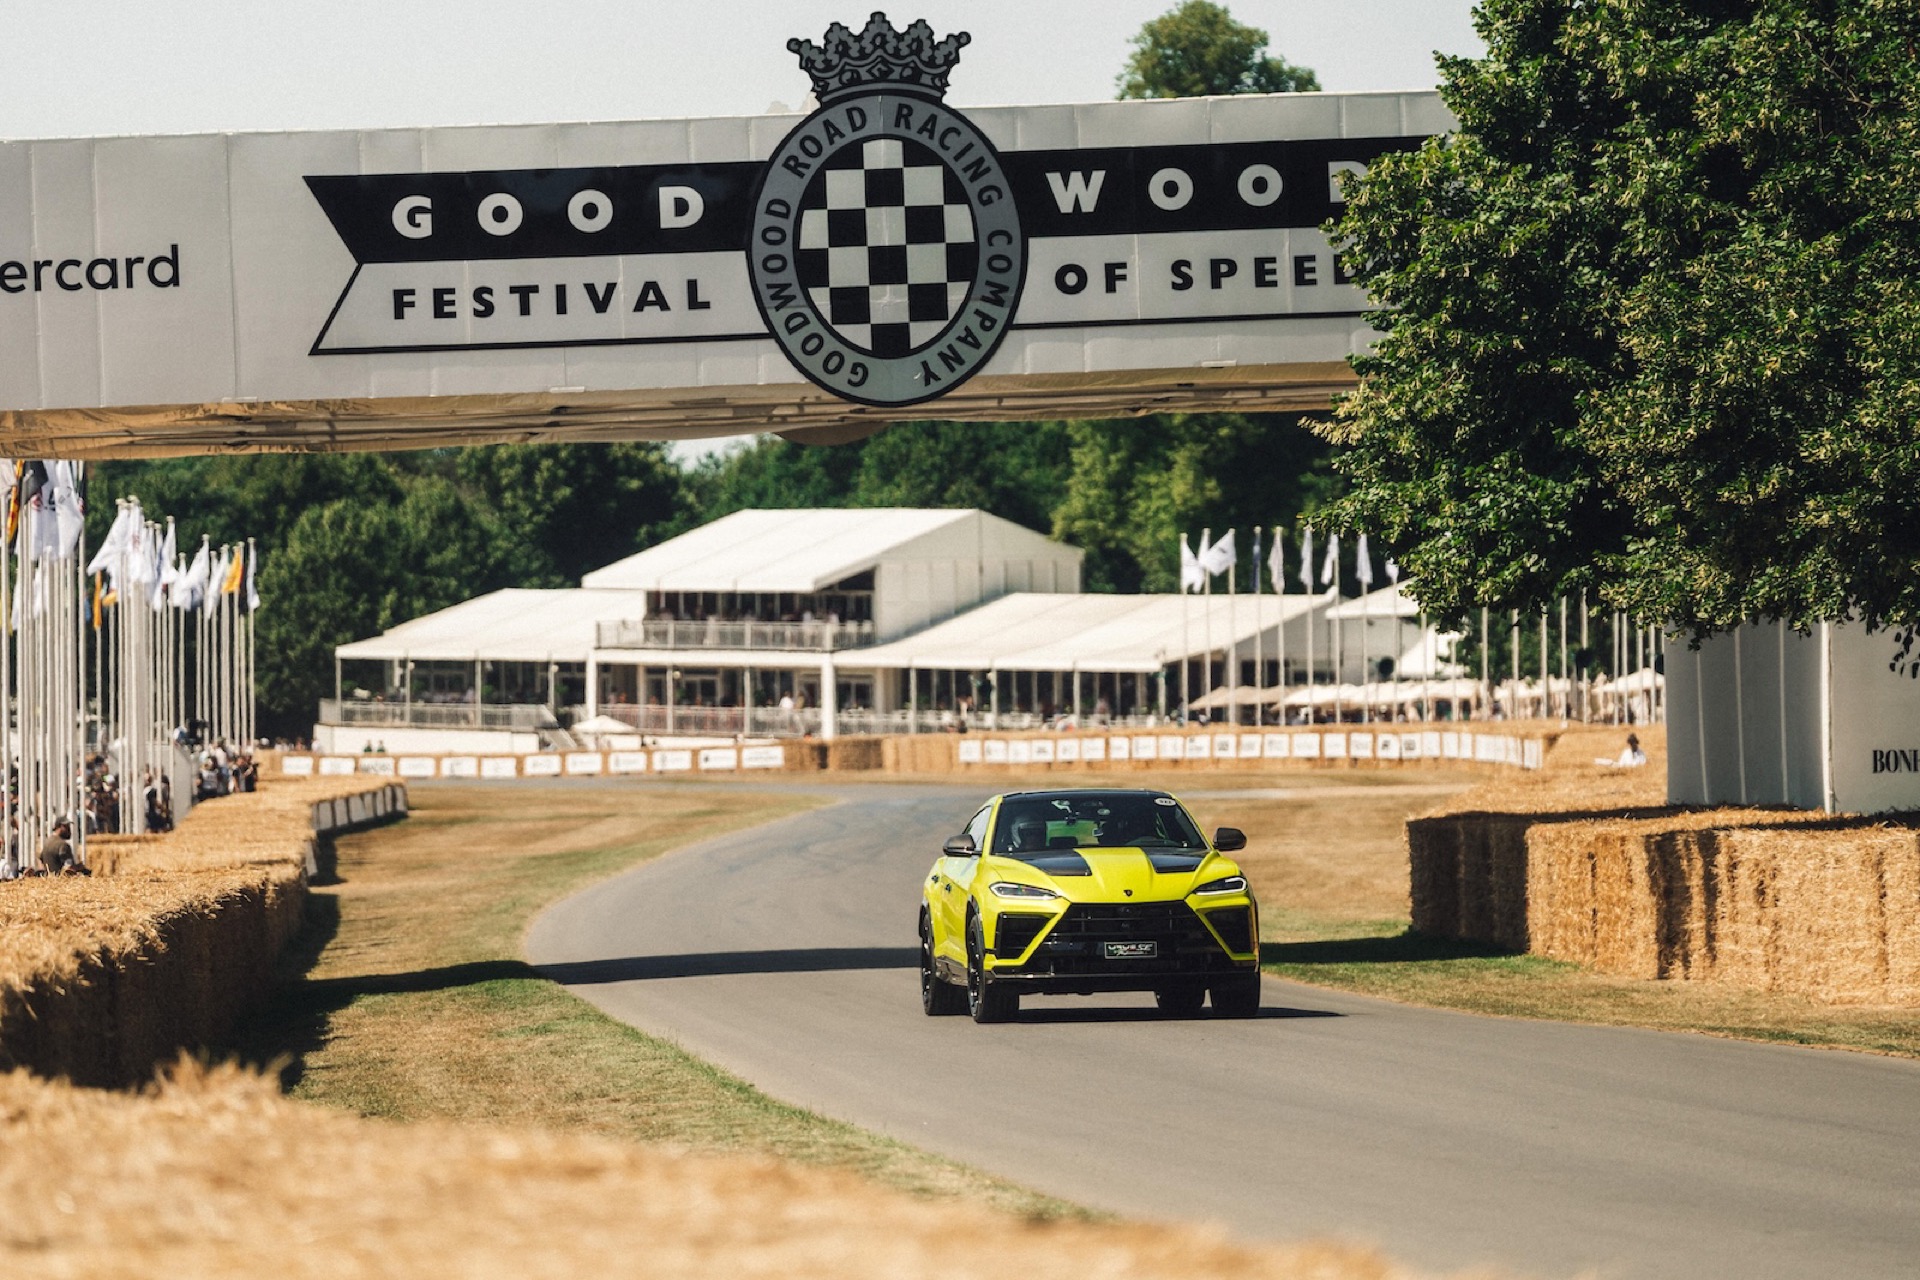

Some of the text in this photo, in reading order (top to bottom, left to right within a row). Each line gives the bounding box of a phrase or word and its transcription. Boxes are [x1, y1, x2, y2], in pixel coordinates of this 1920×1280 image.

[782, 102, 1004, 207] ROAD RACING
[391, 185, 705, 240] GOOD
[0, 243, 180, 293] ercard
[393, 278, 712, 321] FESTIVAL
[1054, 261, 1128, 295] OF
[761, 198, 869, 388] GOODWOOD
[919, 228, 1013, 388] COMPANY
